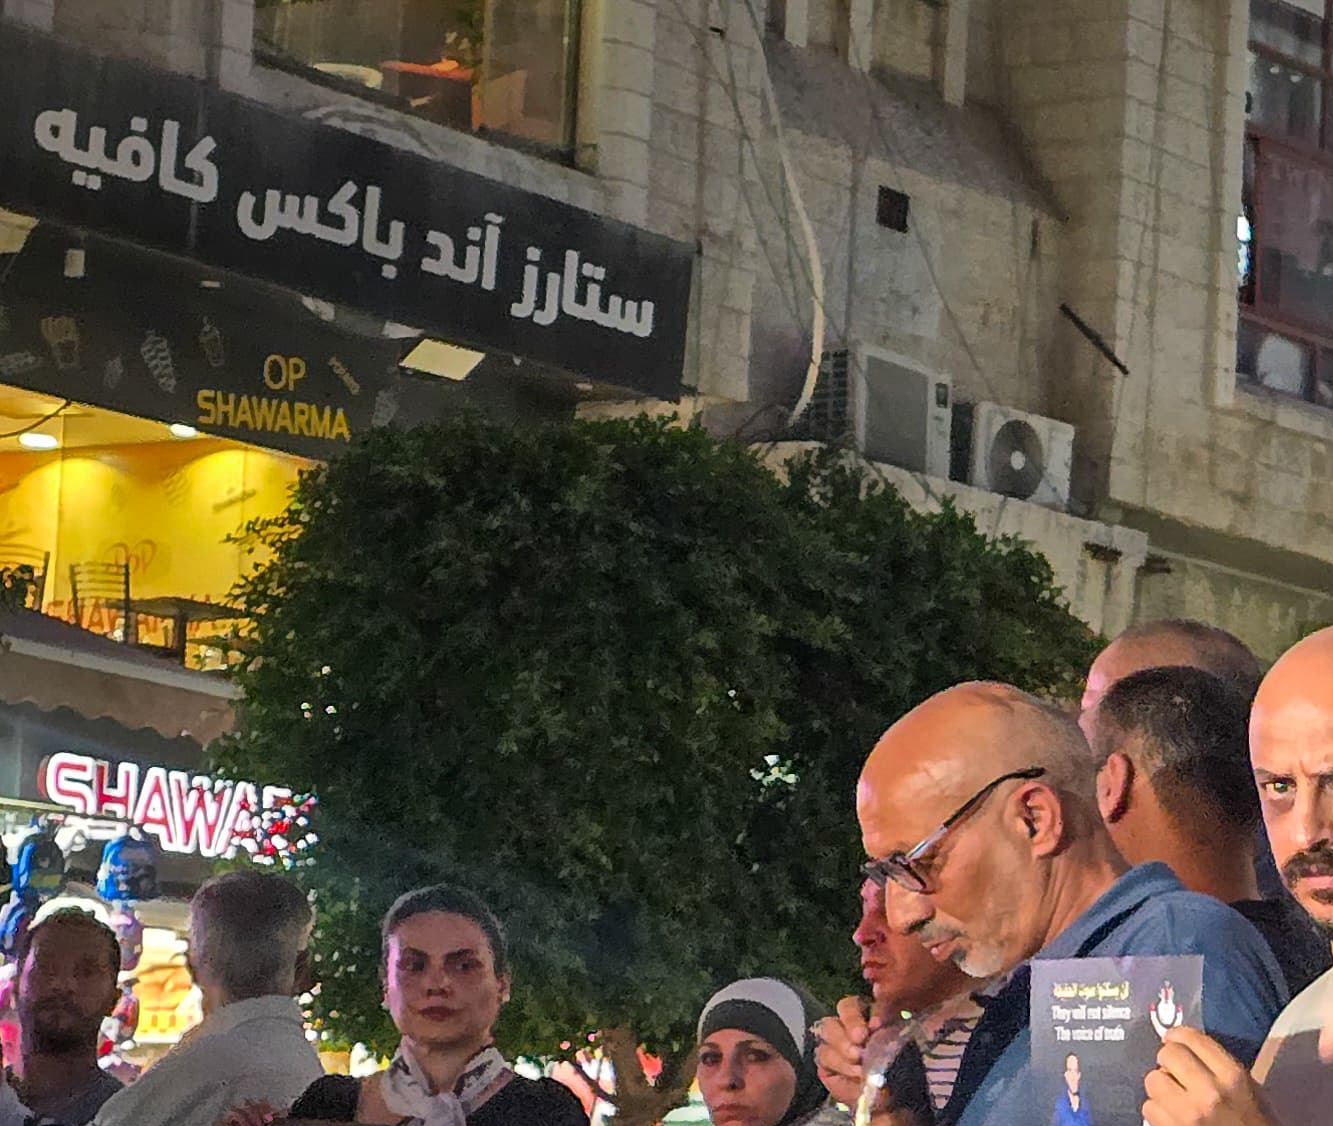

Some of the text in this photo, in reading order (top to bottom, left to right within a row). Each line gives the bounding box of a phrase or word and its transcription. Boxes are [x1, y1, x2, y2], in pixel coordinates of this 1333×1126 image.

[33, 104, 655, 338] ستارز آند باكس كافيه
[264, 354, 306, 392] OP
[197, 389, 351, 441] SHAWARMA
